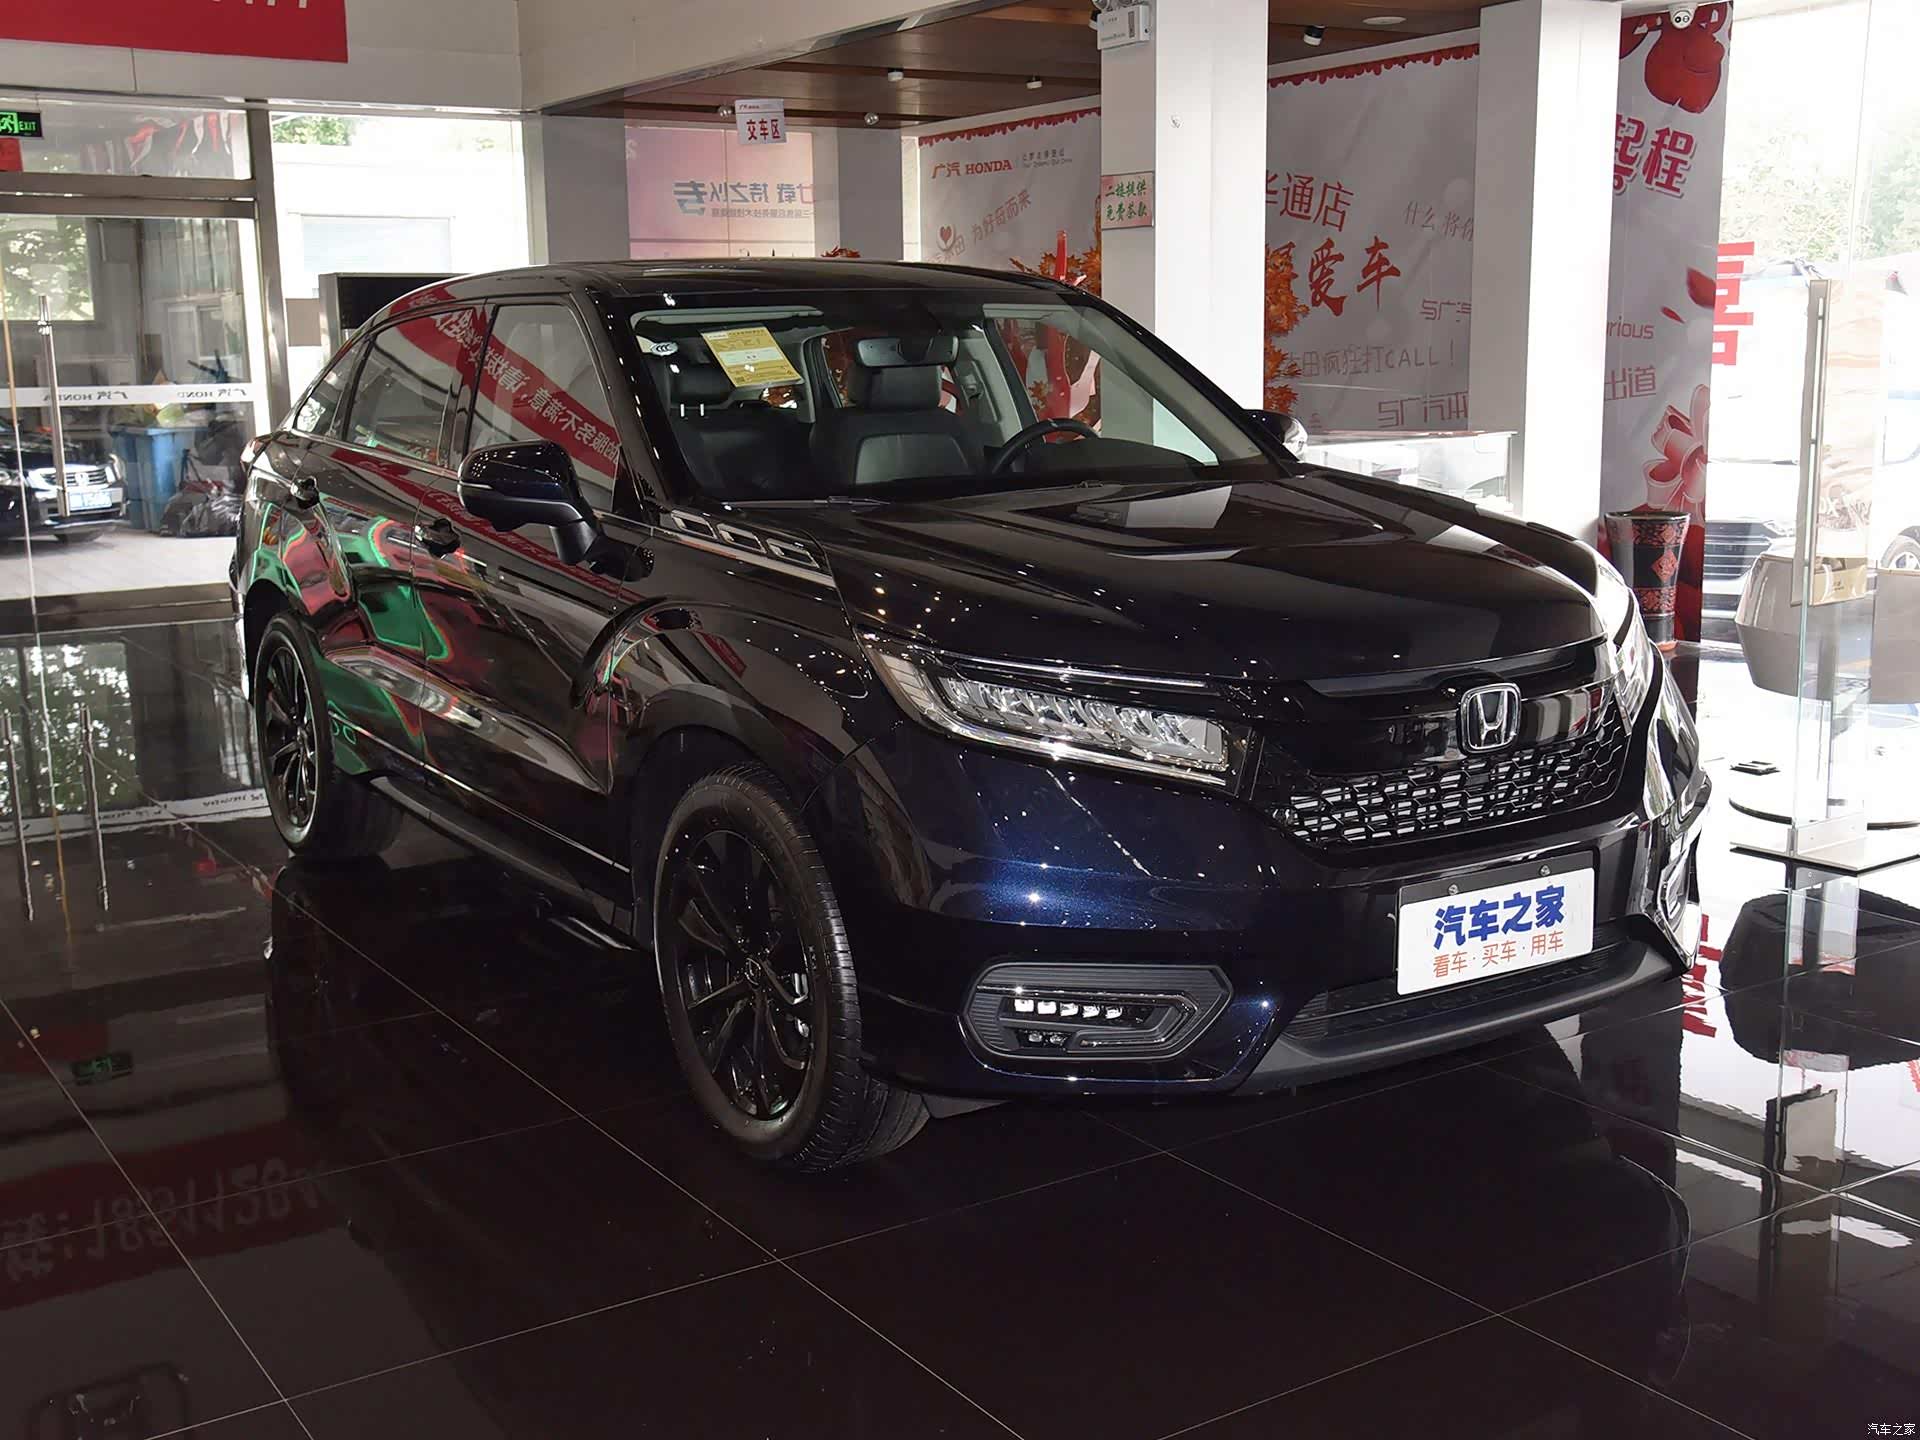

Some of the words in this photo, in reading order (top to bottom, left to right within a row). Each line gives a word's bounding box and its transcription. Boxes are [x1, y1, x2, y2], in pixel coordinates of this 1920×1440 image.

[19, 121, 37, 132] EXIT
[746, 119, 781, 141] 交车区
[932, 162, 961, 179] 广汽
[965, 159, 1013, 175] HONDA
[1433, 885, 1566, 950] 汽车之家
